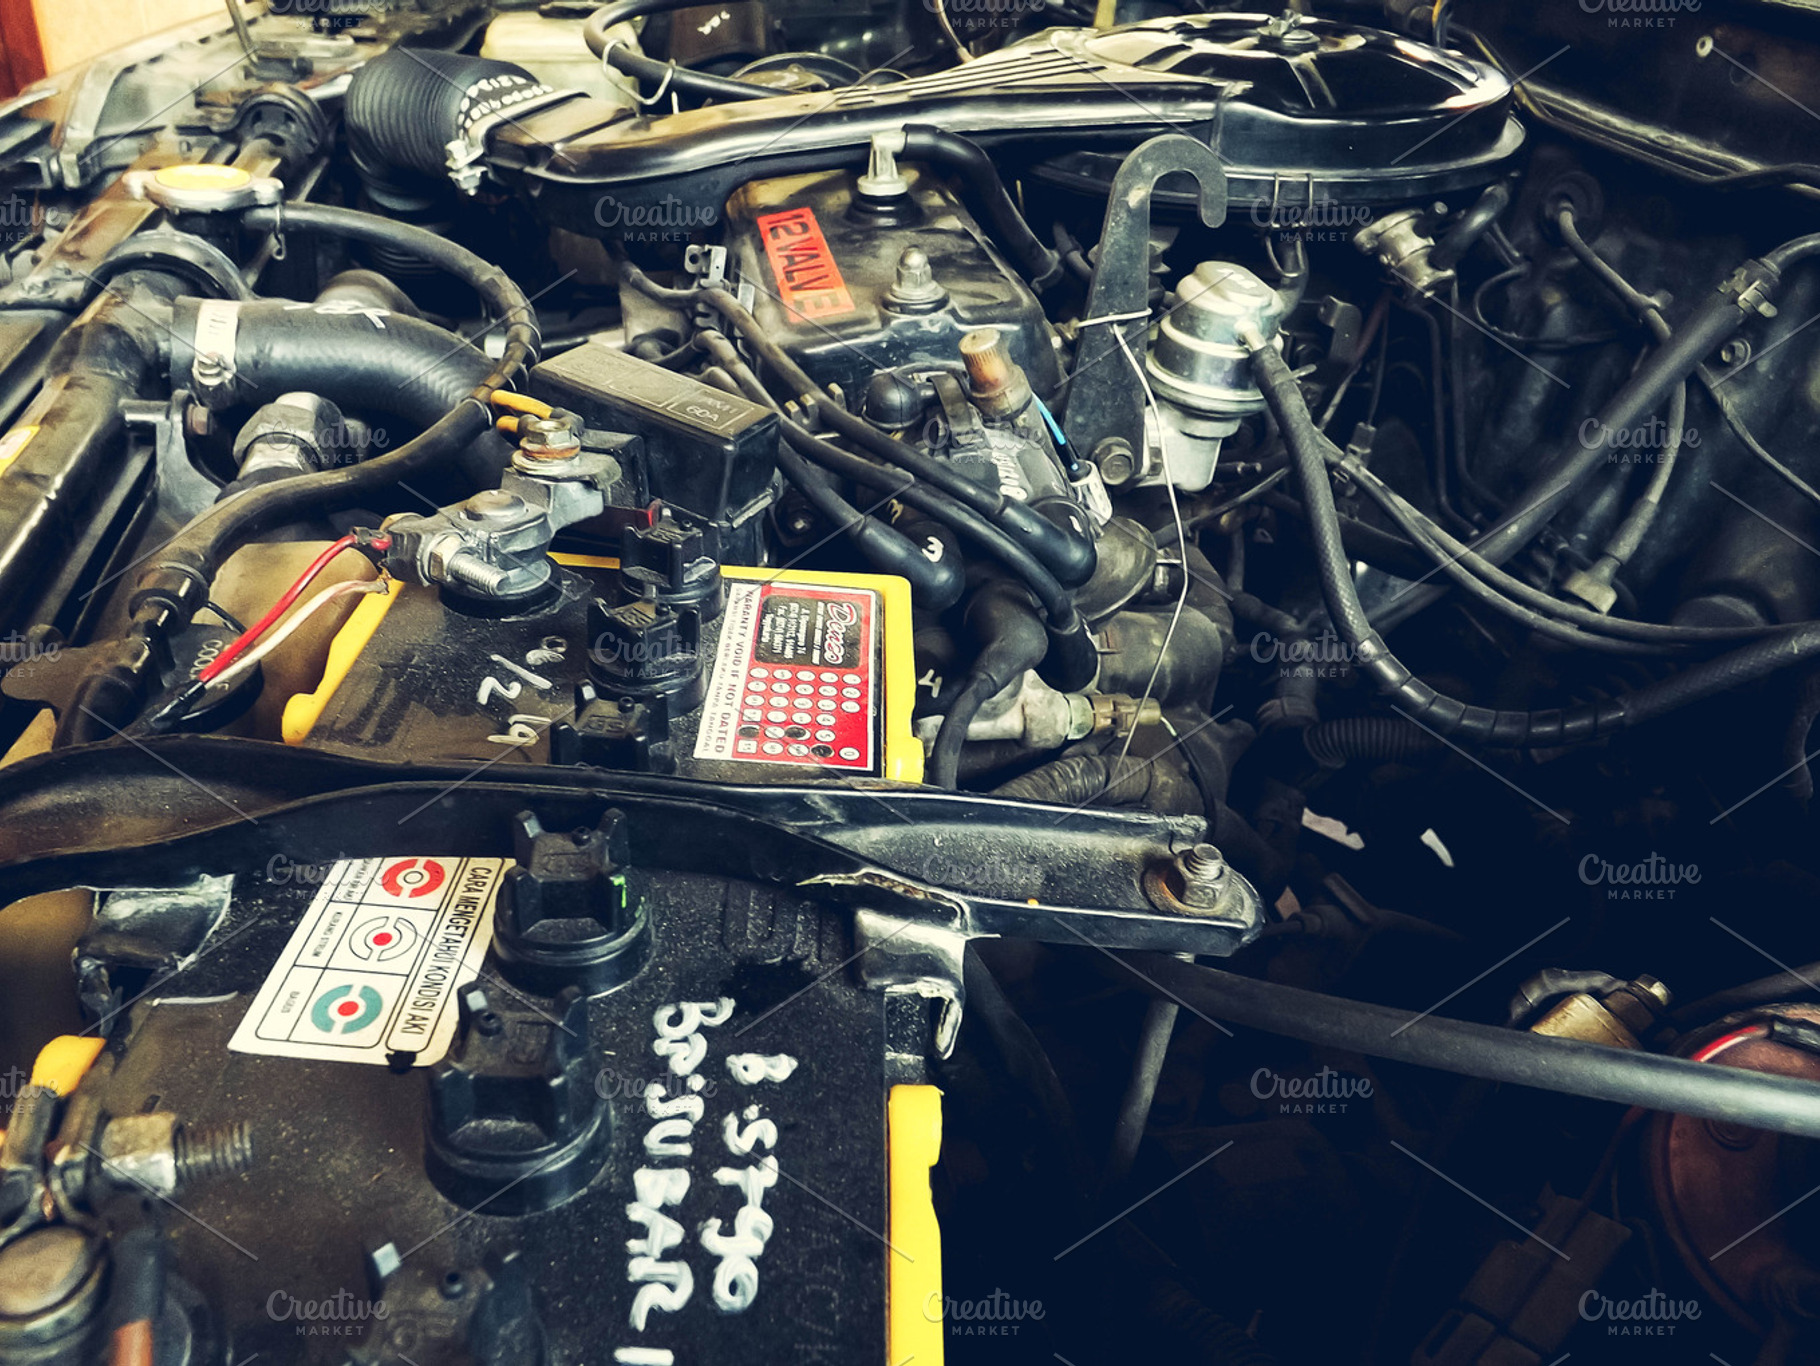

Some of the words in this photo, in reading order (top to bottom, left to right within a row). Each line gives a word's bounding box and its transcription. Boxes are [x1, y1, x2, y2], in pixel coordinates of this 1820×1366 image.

[921, 536, 944, 562] 3
[733, 641, 744, 666] VOID
[731, 668, 739, 679] IF
[725, 684, 737, 706] NOT
[715, 712, 731, 753] DATED
[464, 866, 493, 894] CARA
[434, 893, 480, 964] MENGETAHUI
[410, 966, 450, 1014] KONDISI
[401, 1014, 430, 1035] AKI
